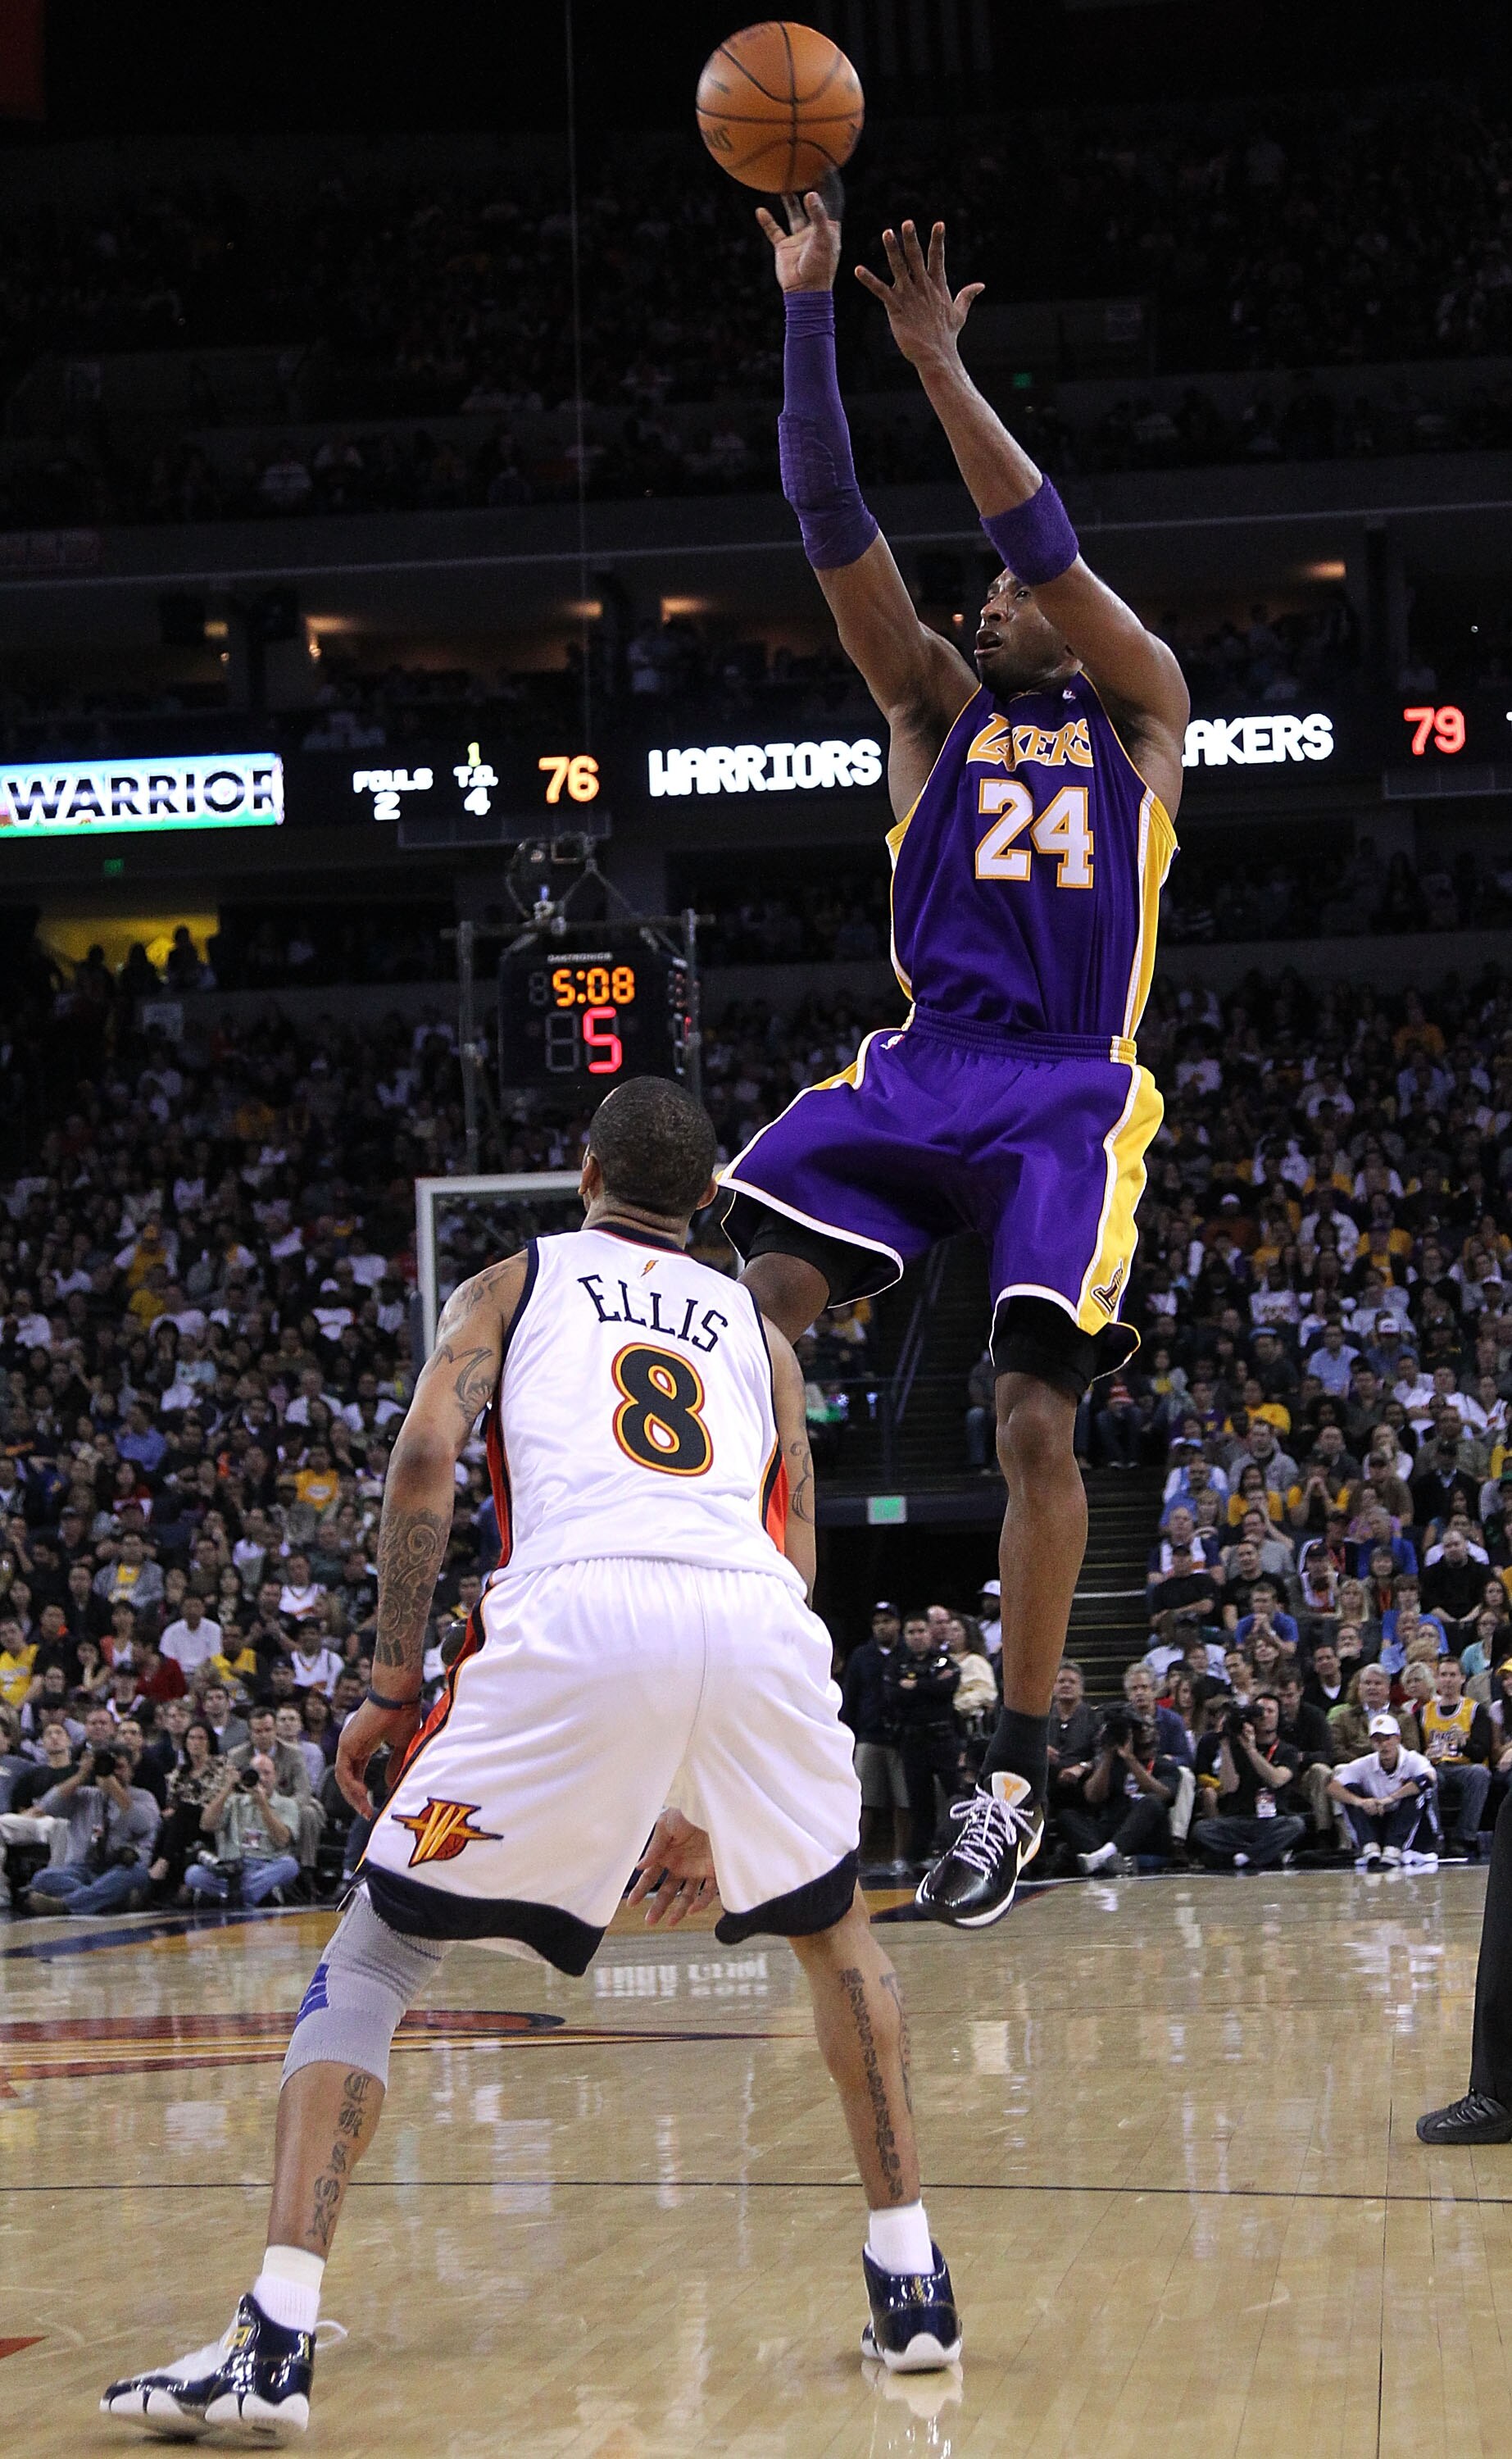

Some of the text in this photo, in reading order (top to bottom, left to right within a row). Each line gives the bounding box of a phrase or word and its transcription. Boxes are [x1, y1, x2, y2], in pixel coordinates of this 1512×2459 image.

[966, 712, 1094, 772] LAKERS
[1182, 713, 1334, 767] AKERS
[1404, 706, 1466, 755] 79
[353, 768, 434, 793] FOULS
[538, 755, 600, 803] 76
[648, 739, 883, 797] WARRIORS
[374, 792, 401, 820] 2
[464, 787, 491, 816] 4
[975, 778, 1094, 889] 24
[552, 966, 635, 1007] 5:08
[583, 1007, 622, 1073] 5
[577, 1275, 729, 1352] ELLIS
[611, 1342, 714, 1477] 8
